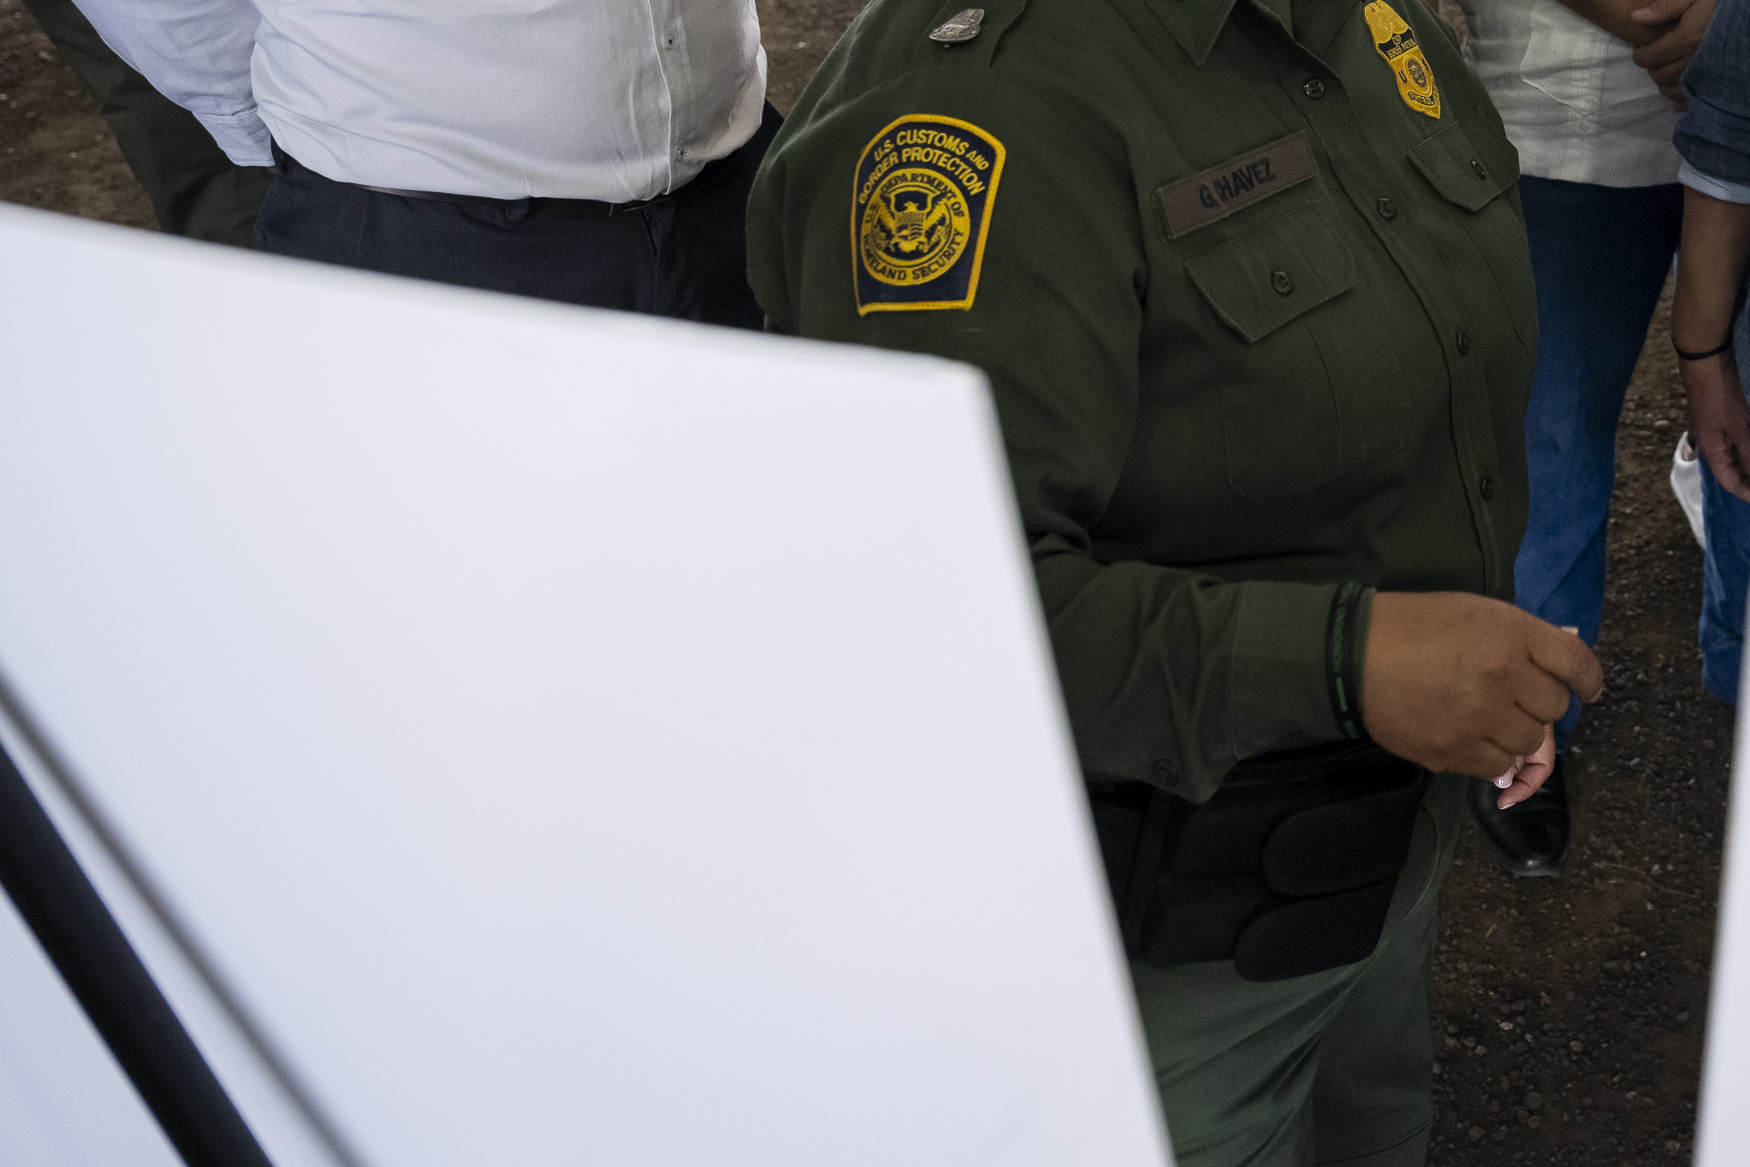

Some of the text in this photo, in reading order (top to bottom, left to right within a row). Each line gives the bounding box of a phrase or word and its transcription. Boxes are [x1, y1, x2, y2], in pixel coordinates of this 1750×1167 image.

[896, 129, 969, 156] CUSTOMS
[965, 150, 990, 170] AND
[858, 146, 986, 204] BORDER PROTECTION
[880, 173, 957, 201] DEPARTMENT
[951, 201, 966, 217] OF
[863, 229, 963, 280] HOMELAND SECURITY
